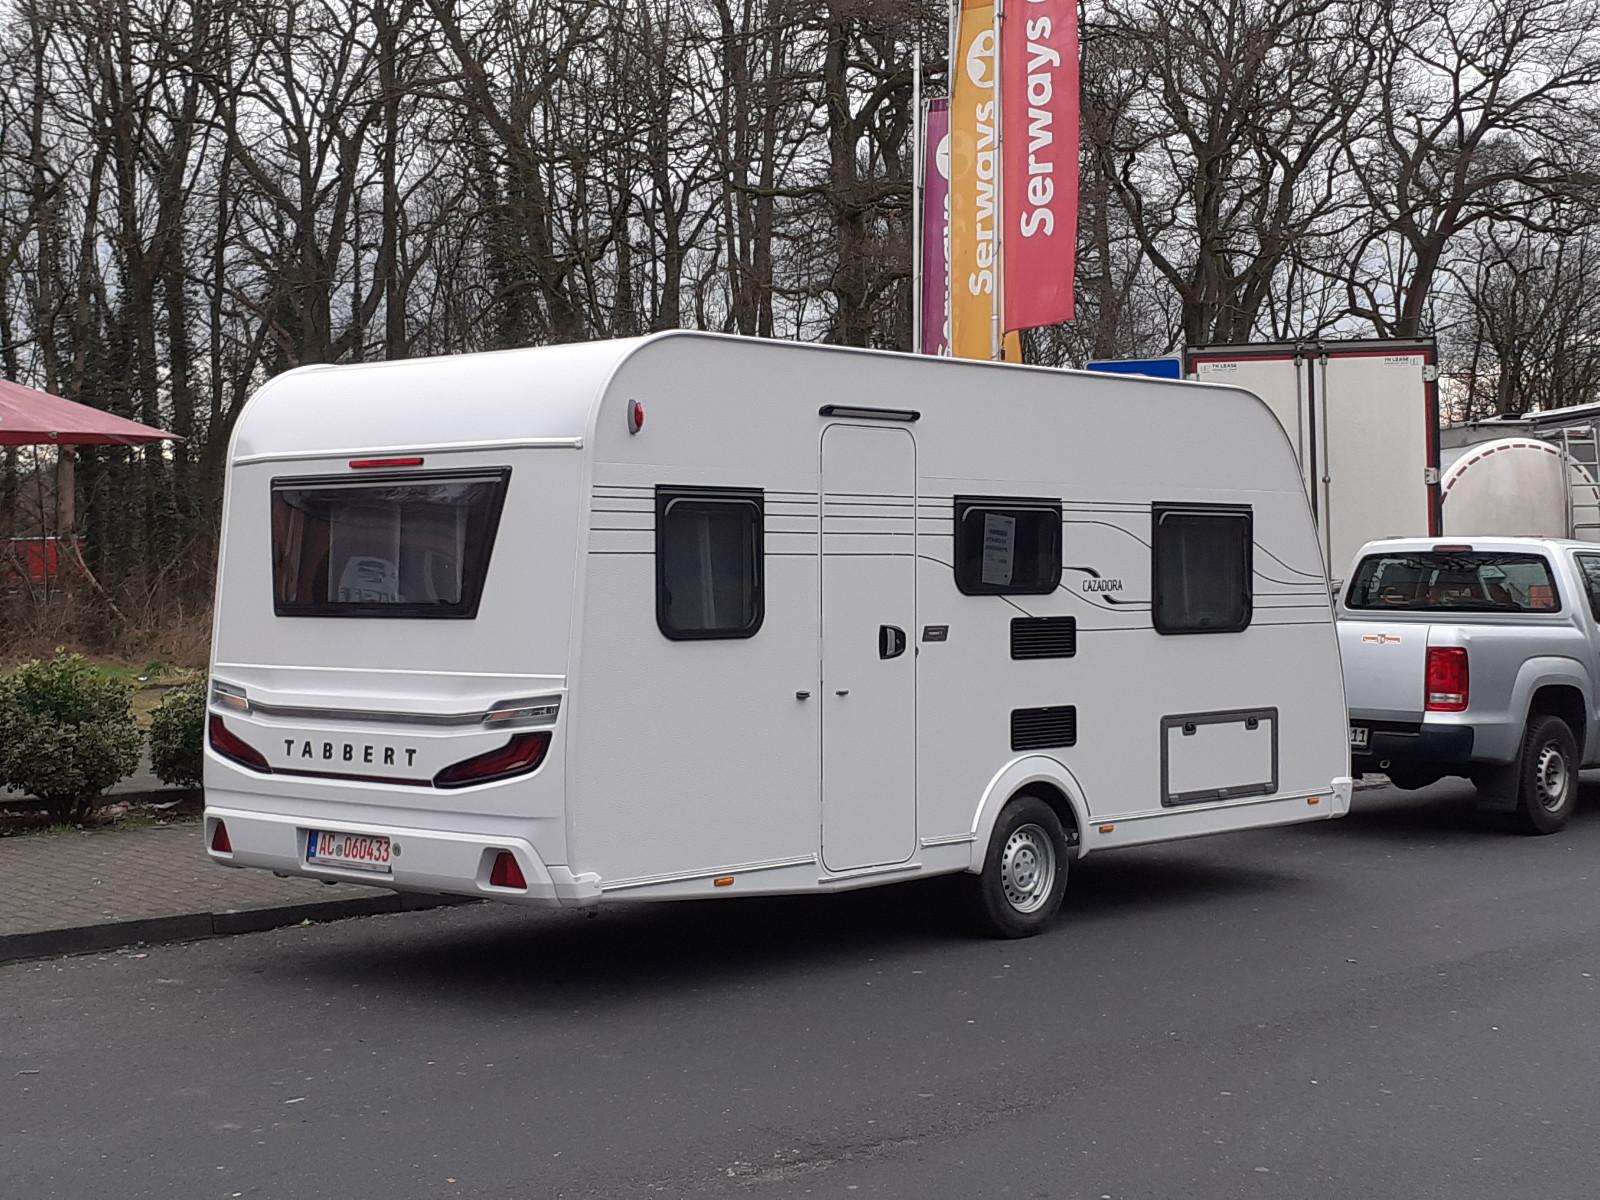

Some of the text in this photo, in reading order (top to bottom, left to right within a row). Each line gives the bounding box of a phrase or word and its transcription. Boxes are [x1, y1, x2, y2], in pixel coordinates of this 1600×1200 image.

[1020, 16, 1060, 238] Serways
[969, 101, 993, 296] Serways
[1082, 579, 1123, 592] CAZADORA
[284, 739, 417, 767] TABBERT
[319, 833, 391, 862] AC 060433
